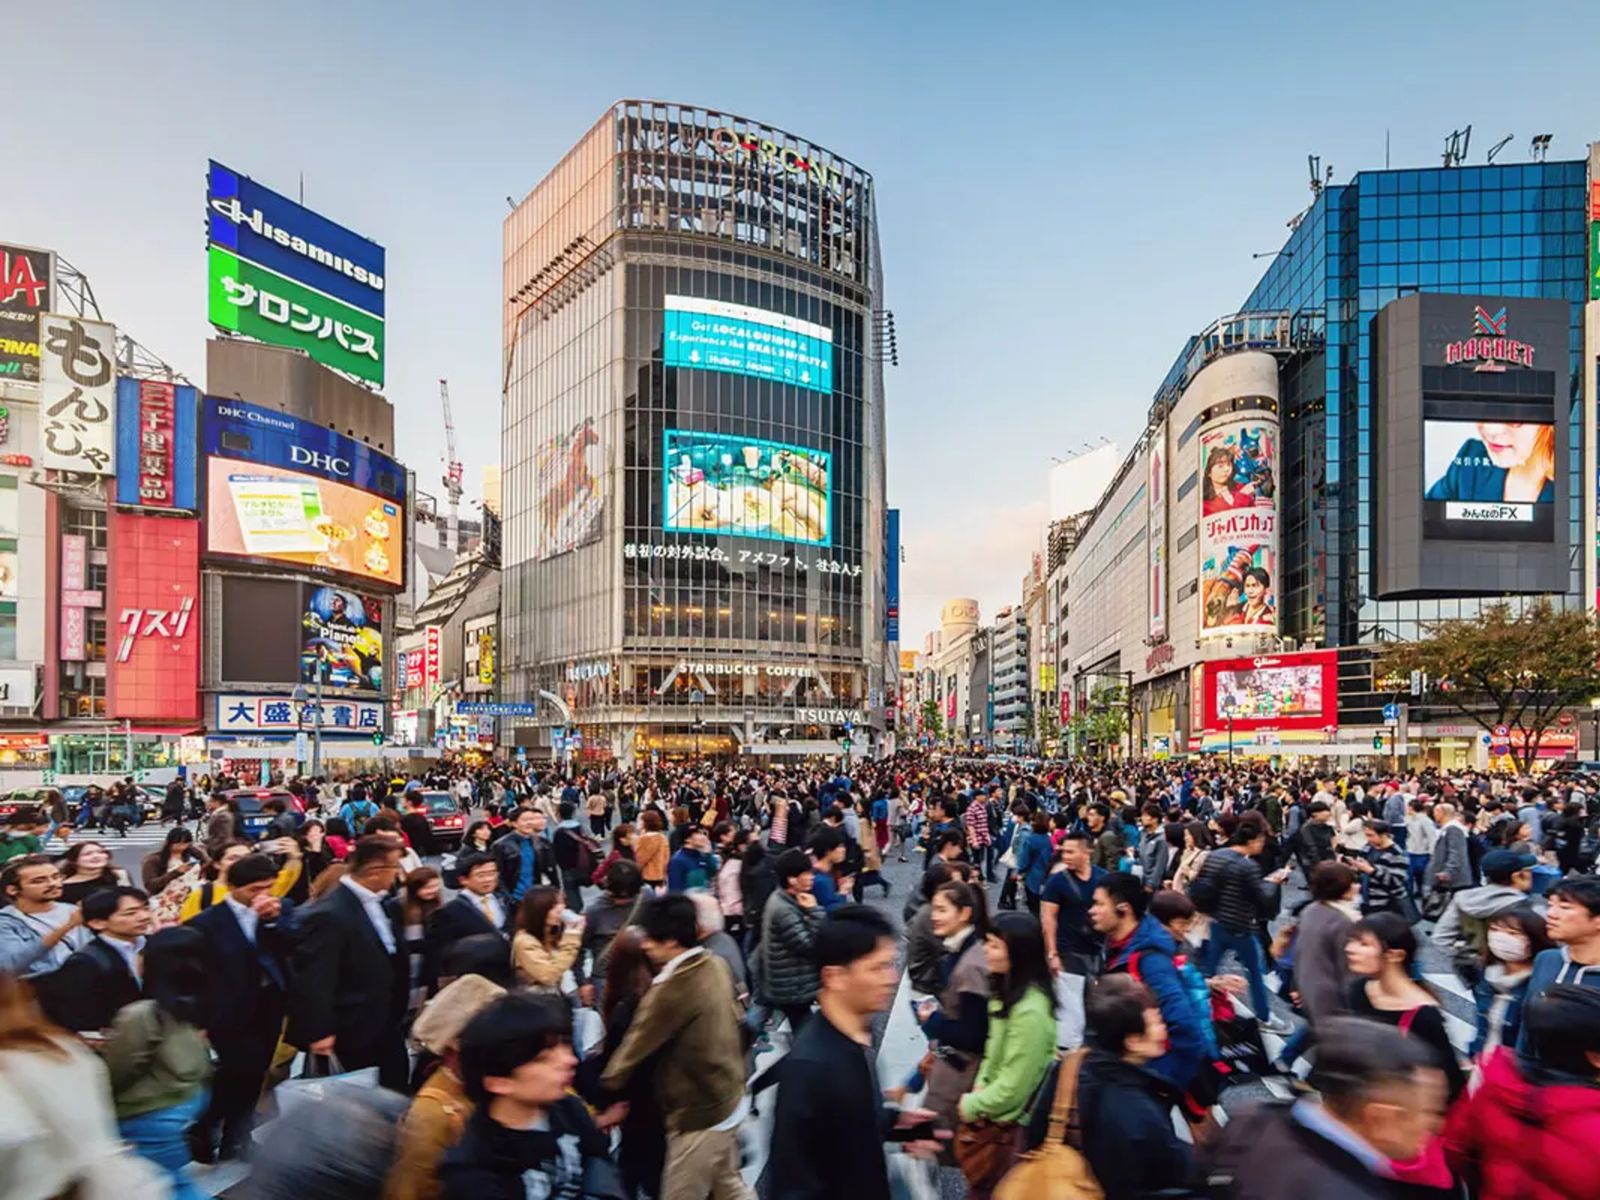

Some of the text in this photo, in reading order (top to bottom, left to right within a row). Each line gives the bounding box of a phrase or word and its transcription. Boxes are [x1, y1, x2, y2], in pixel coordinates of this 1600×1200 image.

[211, 198, 384, 290] Hisamitsu
[221, 275, 379, 360] サロンパス
[713, 323, 751, 338] LOCAL
[1446, 337, 1536, 367] MAGNET
[45, 320, 111, 470] もんじゃ
[217, 405, 295, 431] DHC Channel
[290, 445, 350, 476] DHC
[1461, 506, 1518, 519] みんなのFX
[116, 595, 195, 663] クスリ
[679, 662, 813, 678] STARBUCKS COFFEE
[798, 709, 862, 724] TSUTAYA
